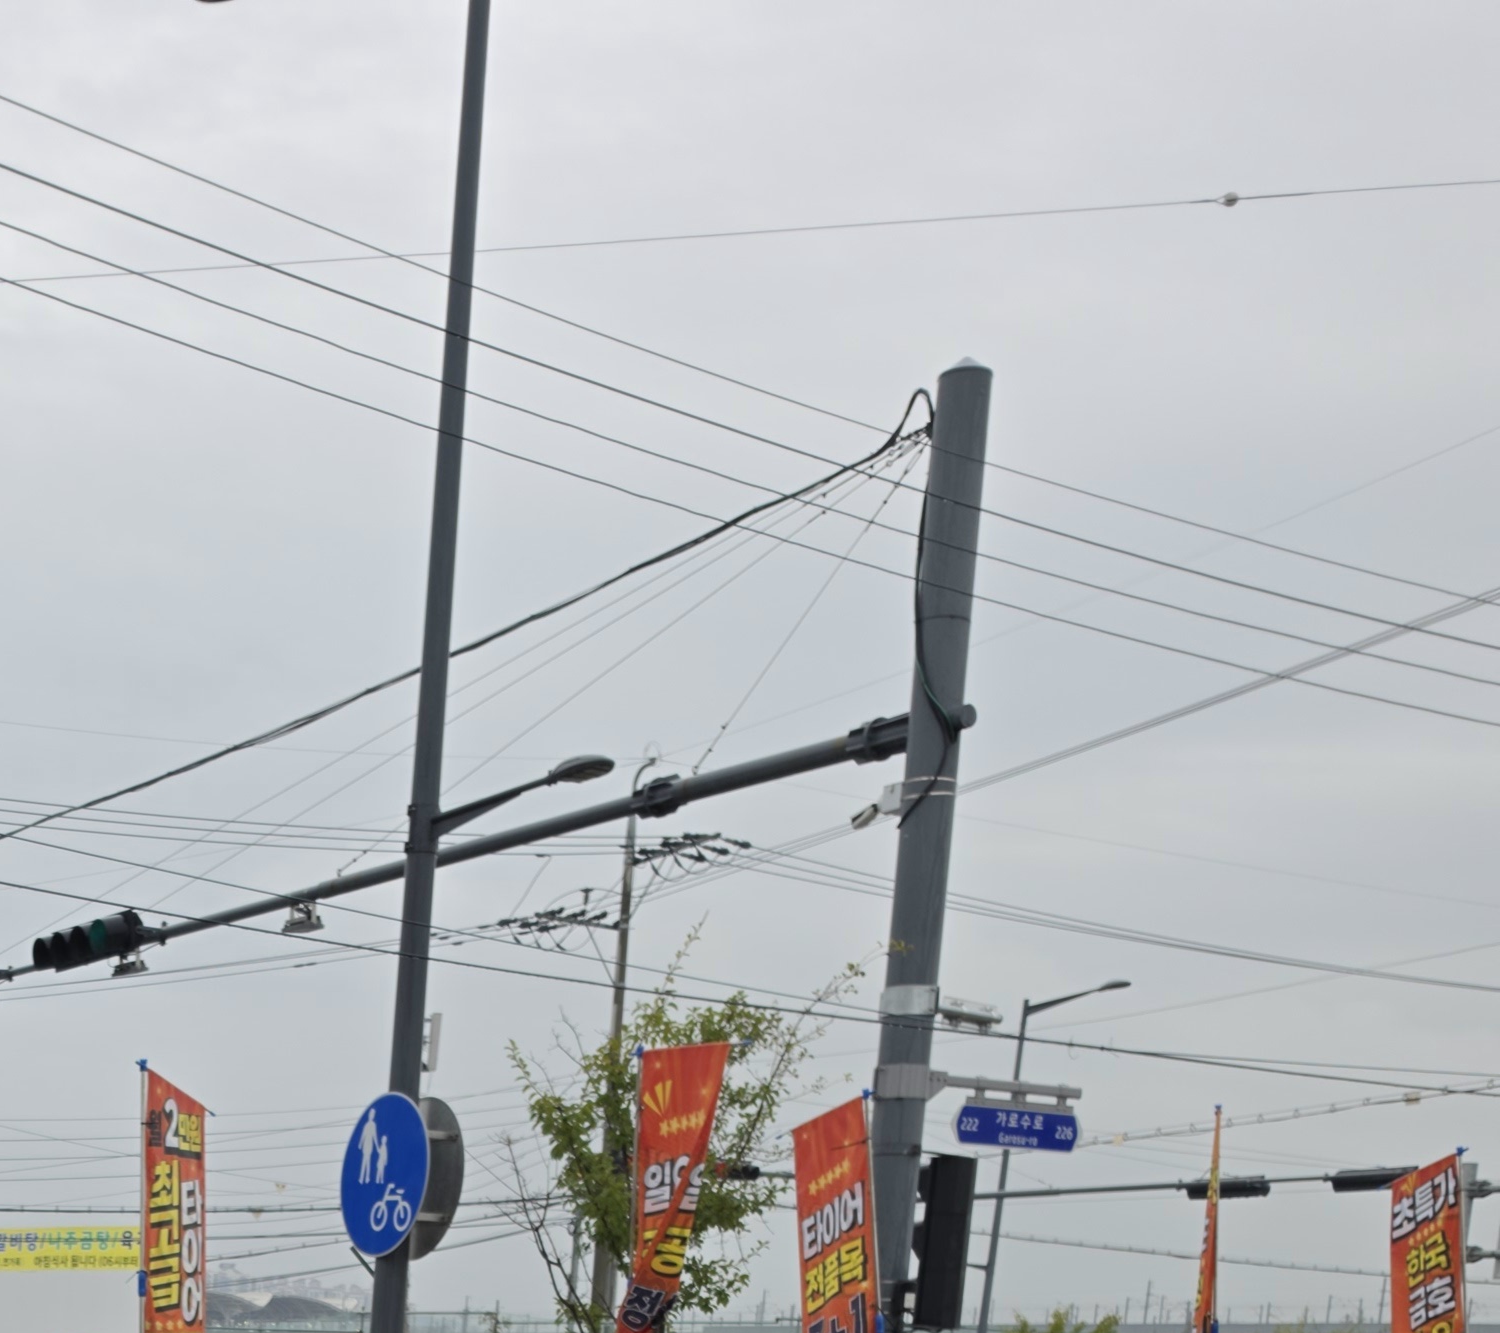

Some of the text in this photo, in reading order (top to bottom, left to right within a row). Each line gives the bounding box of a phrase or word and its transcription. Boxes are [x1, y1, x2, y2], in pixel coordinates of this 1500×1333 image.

[960, 1116, 979, 1132] 222
[996, 1111, 1044, 1130] 가로수로
[1054, 1125, 1074, 1140] 226
[803, 1181, 864, 1260] 타이어
[1392, 1168, 1456, 1240] 초특가
[150, 1160, 180, 1309] 최고급
[1406, 1231, 1449, 1288] 한국
[806, 1237, 866, 1315] 전품목
[1409, 1276, 1456, 1331] 금호
